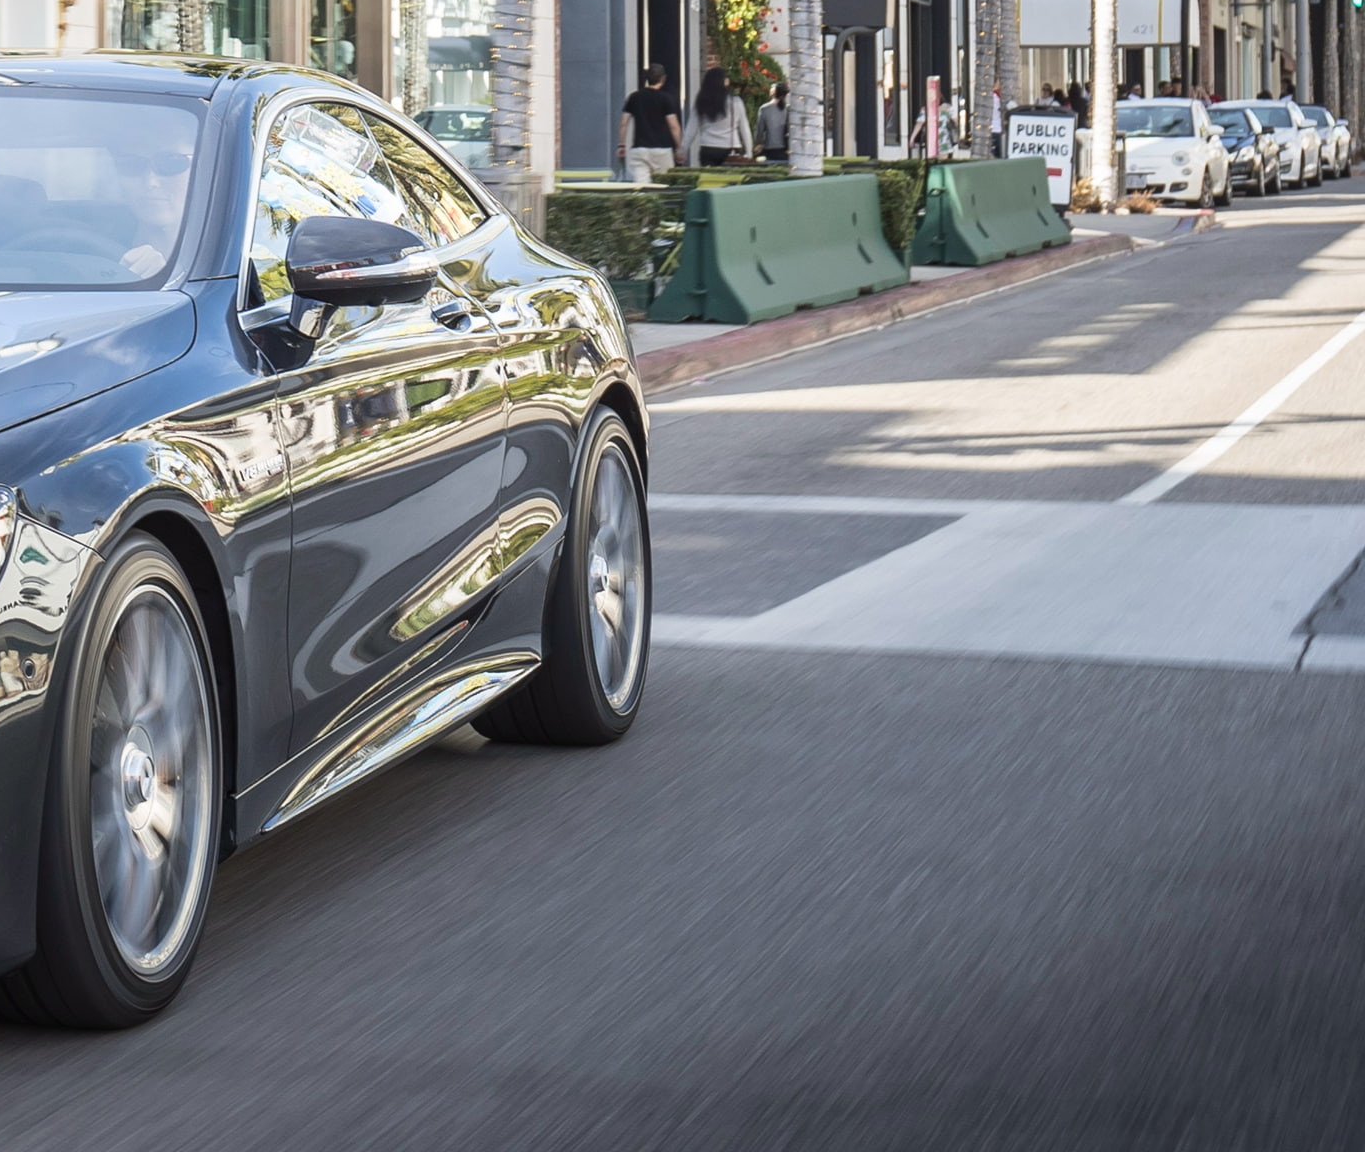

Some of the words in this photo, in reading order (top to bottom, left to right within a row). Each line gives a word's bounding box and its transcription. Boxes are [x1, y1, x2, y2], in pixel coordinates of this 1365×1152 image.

[1133, 24, 1154, 35] 421
[1016, 123, 1067, 138] PUBLIC
[1012, 141, 1069, 157] PARKING
